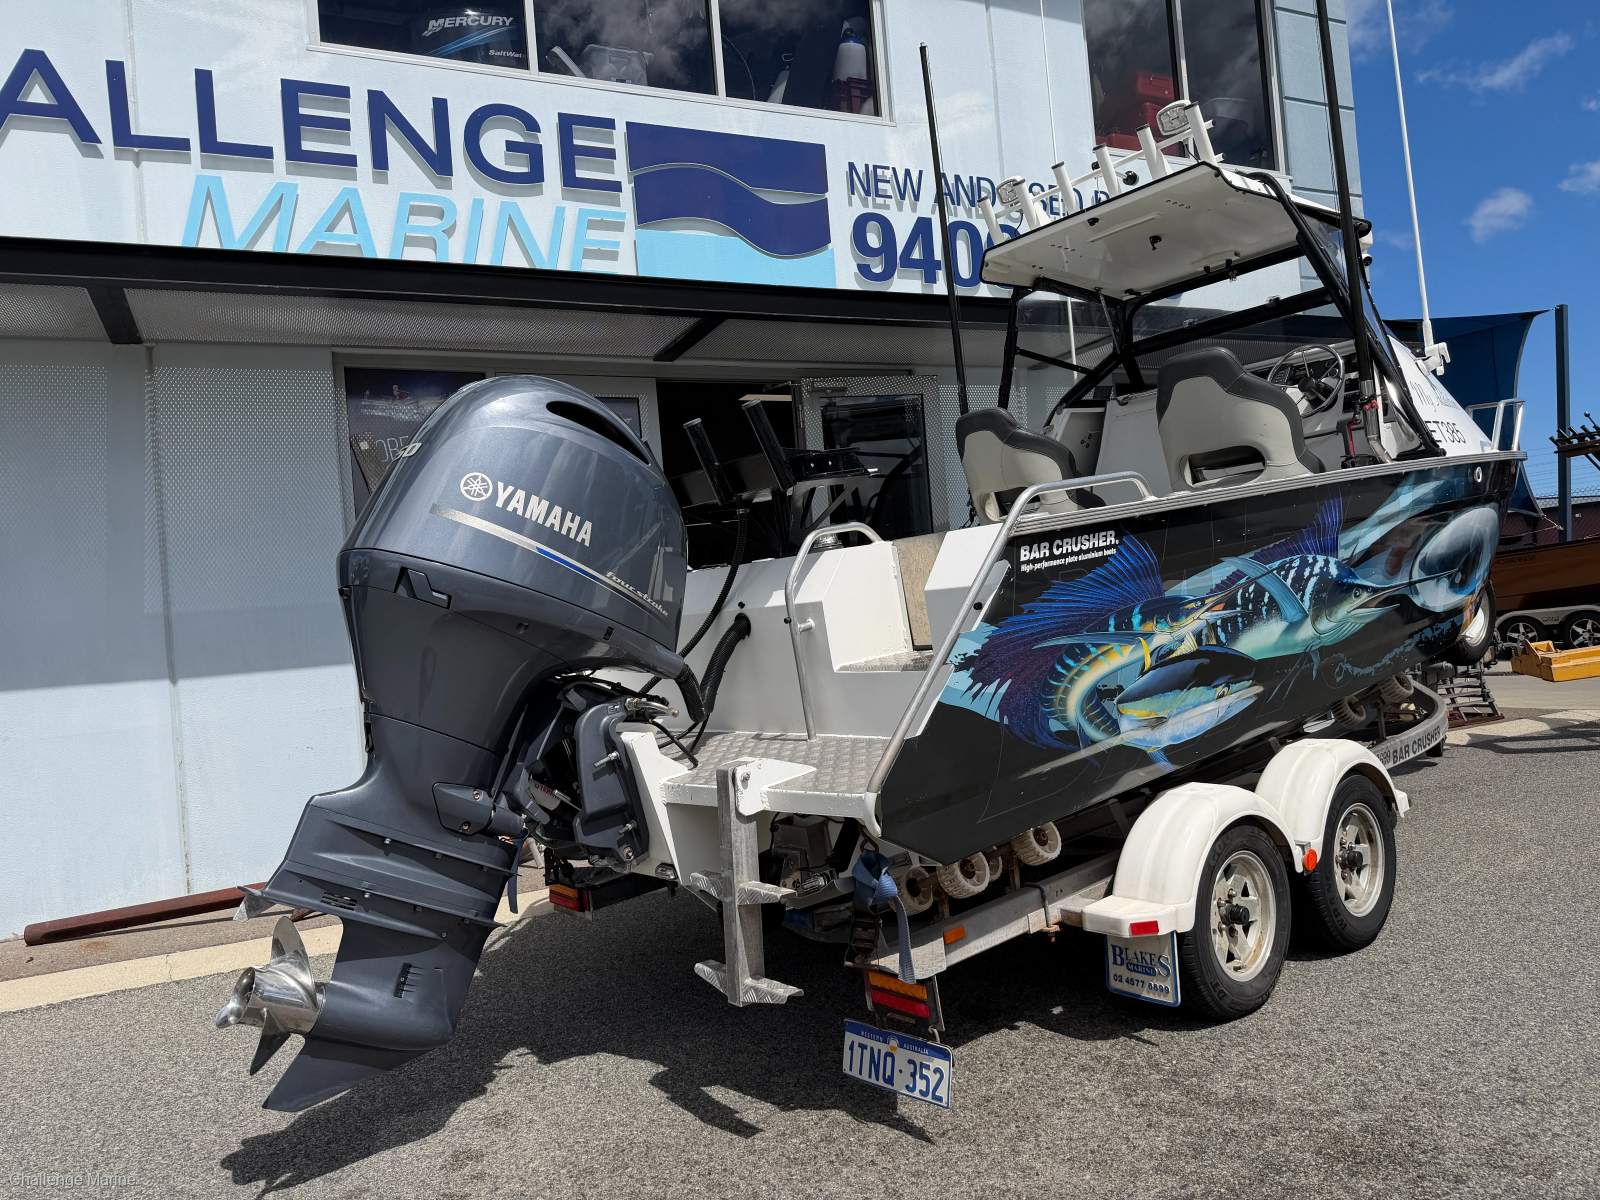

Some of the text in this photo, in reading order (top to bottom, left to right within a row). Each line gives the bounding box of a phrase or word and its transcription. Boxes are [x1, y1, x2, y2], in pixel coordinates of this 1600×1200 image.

[422, 15, 513, 37] MERCURY
[847, 161, 923, 202] NEW
[934, 172, 997, 208] AND
[182, 174, 627, 272] MARINE
[852, 211, 1022, 288] 940
[495, 481, 593, 547] YAMAHA
[1020, 542, 1050, 561] BAR
[1020, 560, 1065, 573] High-performance
[1065, 554, 1078, 565] plate
[1103, 547, 1117, 556] boats
[1392, 744, 1410, 764] BAR
[1411, 726, 1440, 754] CRUSHER
[1111, 944, 1171, 977] BLAKES
[1113, 974, 1123, 983] 02
[848, 1039, 945, 1103] 1TNQ 352
